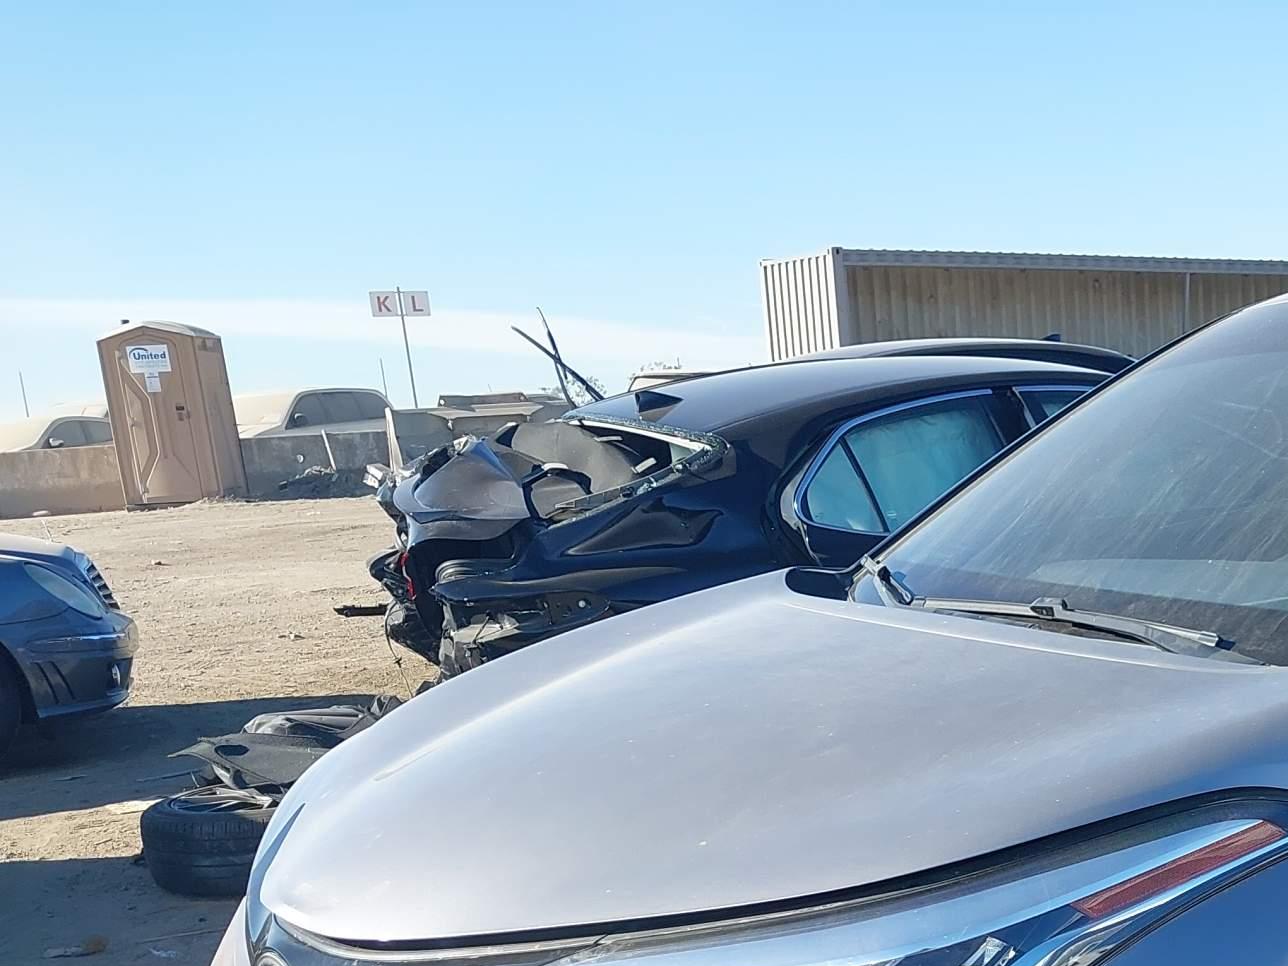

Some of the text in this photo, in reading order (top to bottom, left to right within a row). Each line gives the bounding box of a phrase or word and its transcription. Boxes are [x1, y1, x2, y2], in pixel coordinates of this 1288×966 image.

[376, 295, 392, 312] K
[411, 295, 424, 312] L
[132, 351, 167, 361] United
